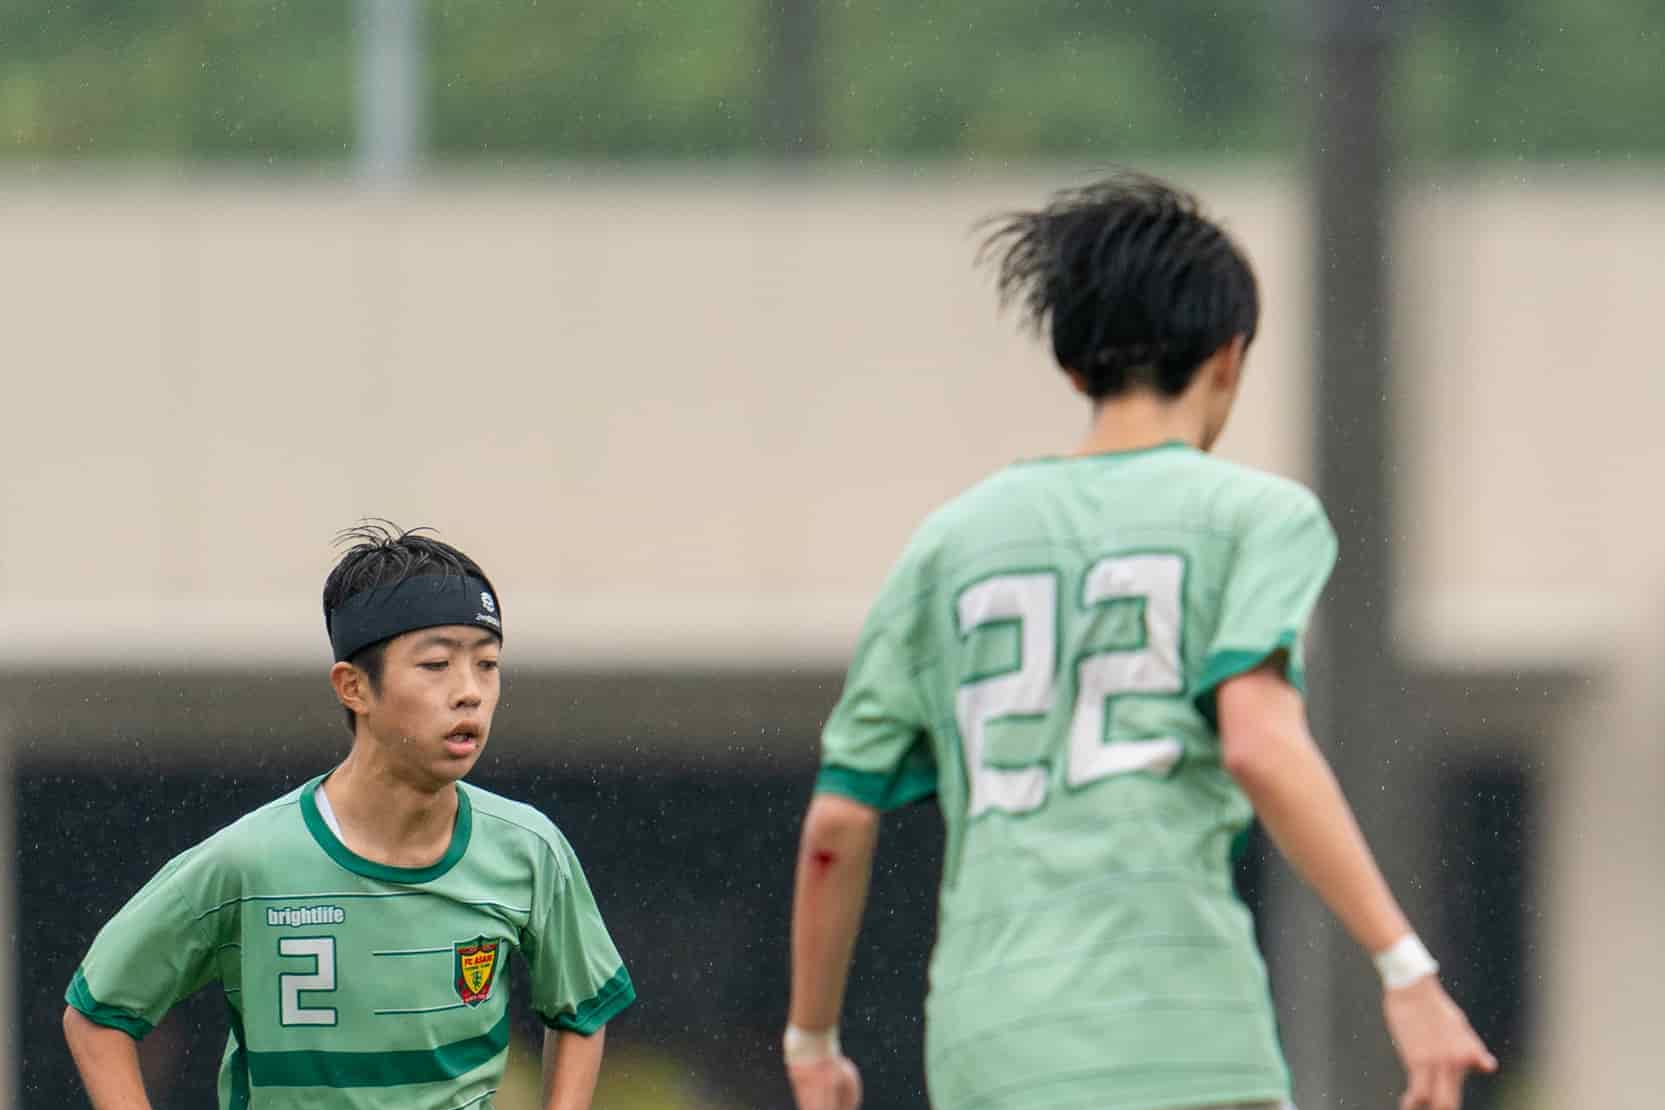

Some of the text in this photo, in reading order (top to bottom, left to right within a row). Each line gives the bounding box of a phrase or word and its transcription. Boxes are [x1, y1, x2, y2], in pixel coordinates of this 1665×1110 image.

[954, 552, 1185, 818] 22
[267, 905, 346, 928] brightlife
[278, 936, 337, 1027] 2
